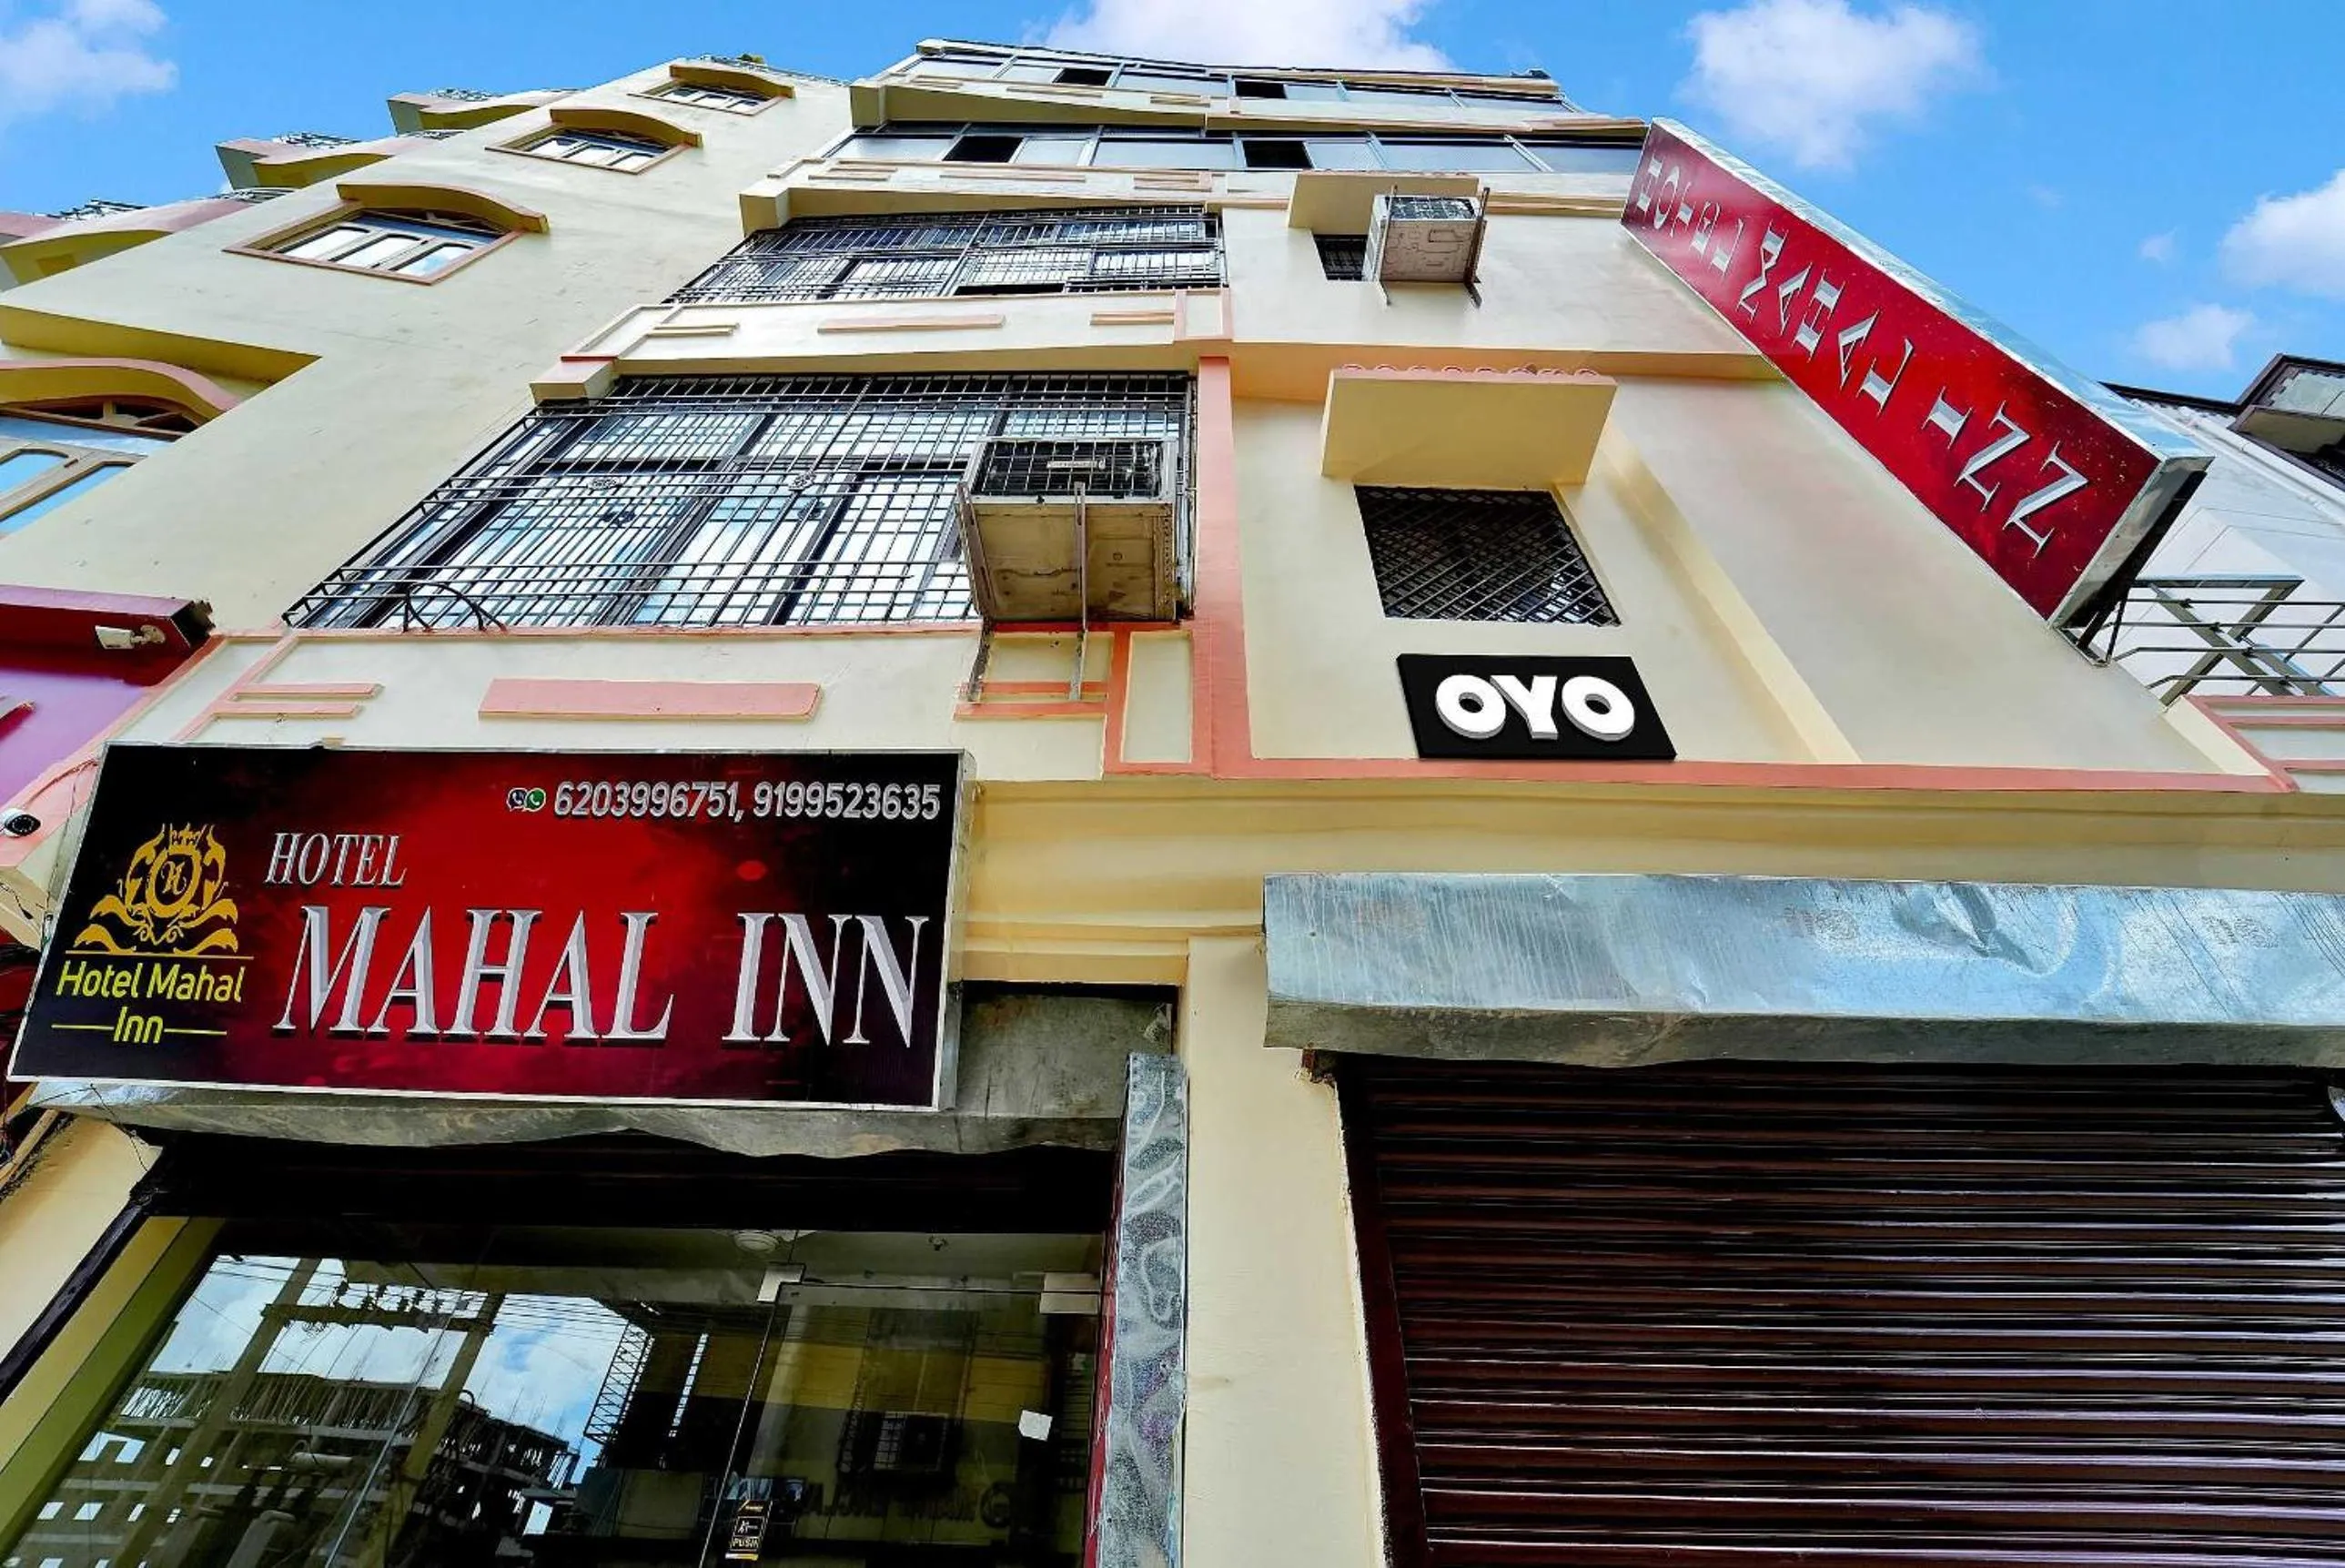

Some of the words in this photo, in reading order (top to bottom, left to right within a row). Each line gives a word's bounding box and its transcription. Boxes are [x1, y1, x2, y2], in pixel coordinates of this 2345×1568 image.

[1736, 226, 1914, 416] MAHAL
[1921, 386, 2089, 560] INN
[1435, 674, 1635, 742] OYO
[554, 781, 743, 823] 6203996751,
[753, 782, 942, 820] 9199523635
[264, 833, 406, 887] HOTEL
[56, 961, 140, 999] Hotel
[147, 963, 246, 1003] Mahal
[273, 905, 674, 1040] MAHAL
[723, 912, 930, 1048] INN
[113, 1006, 165, 1045] Inn
